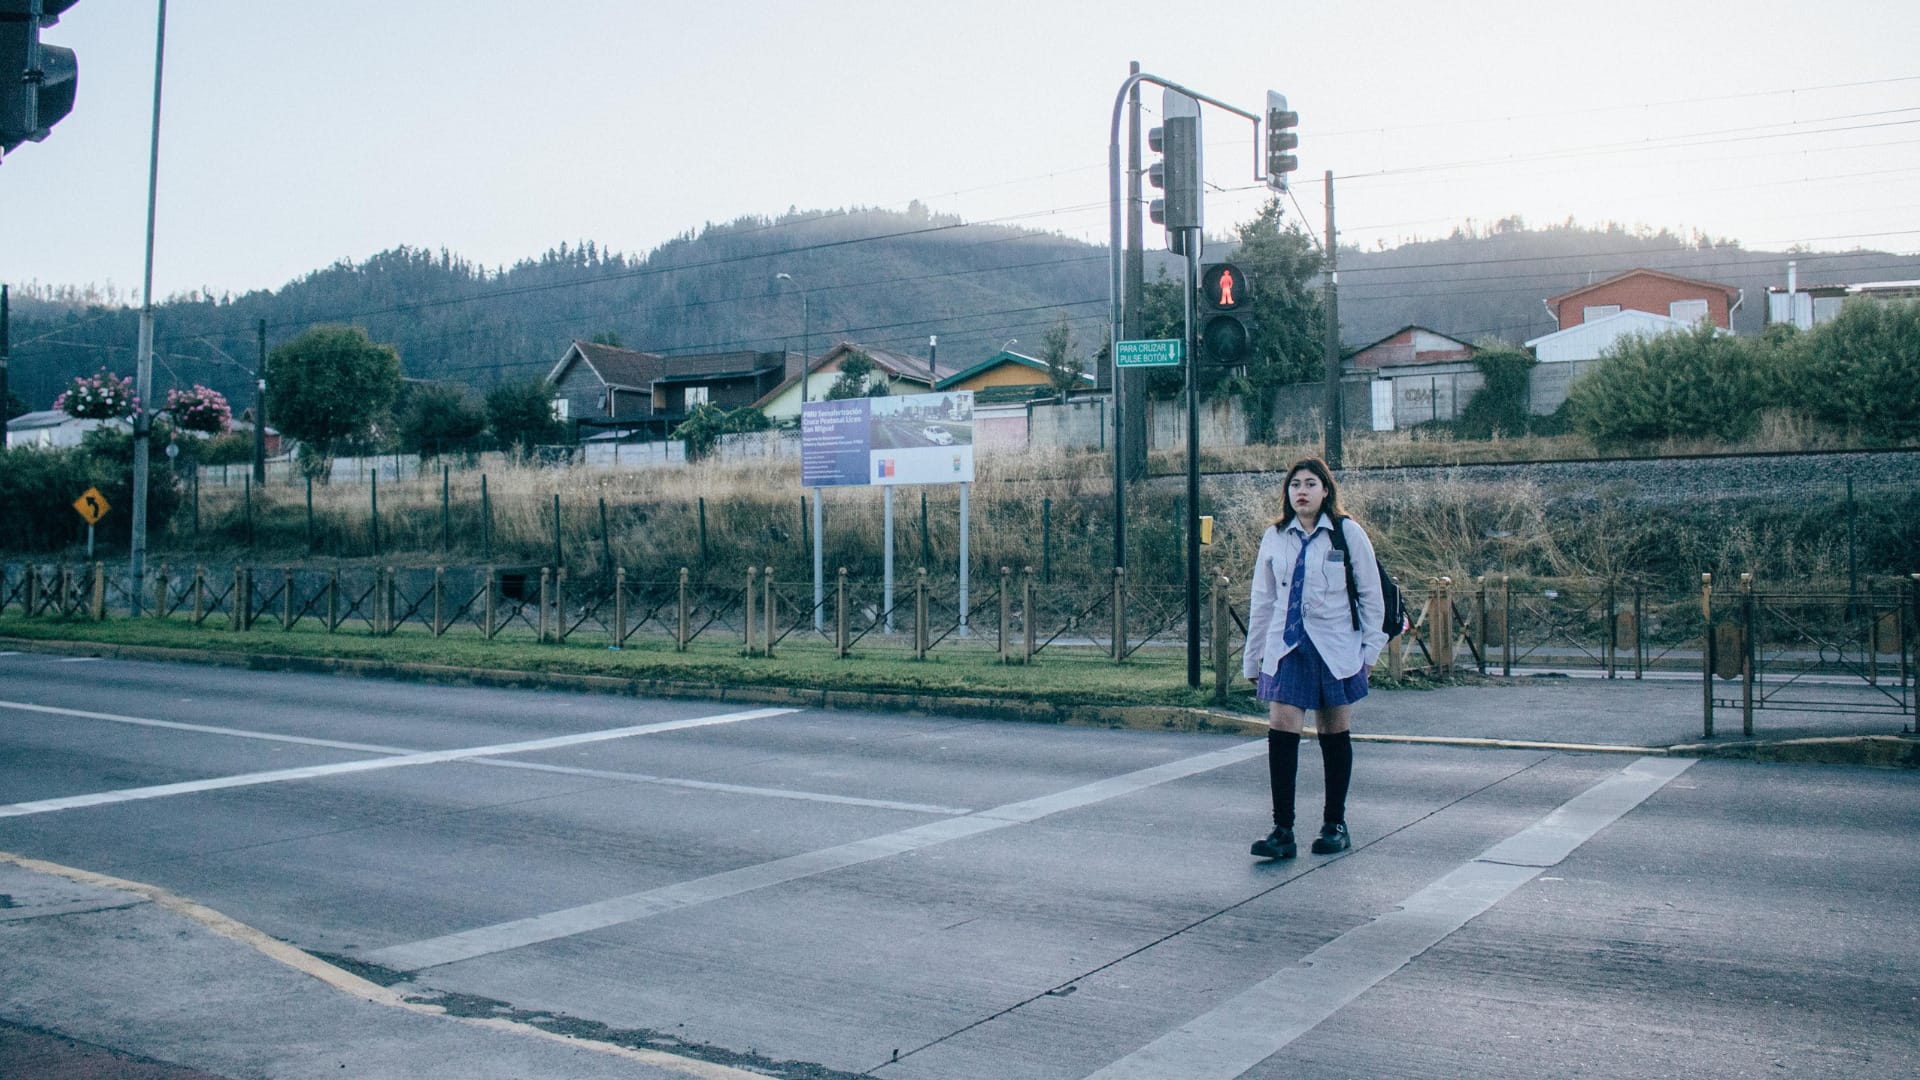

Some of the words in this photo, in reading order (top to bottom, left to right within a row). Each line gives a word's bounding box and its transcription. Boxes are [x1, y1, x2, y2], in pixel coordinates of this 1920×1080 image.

[1120, 344, 1138, 353] PARA
[1138, 343, 1167, 352] CRUZAR
[1120, 354, 1142, 363] PULSE
[1143, 352, 1168, 362] BOTÓN
